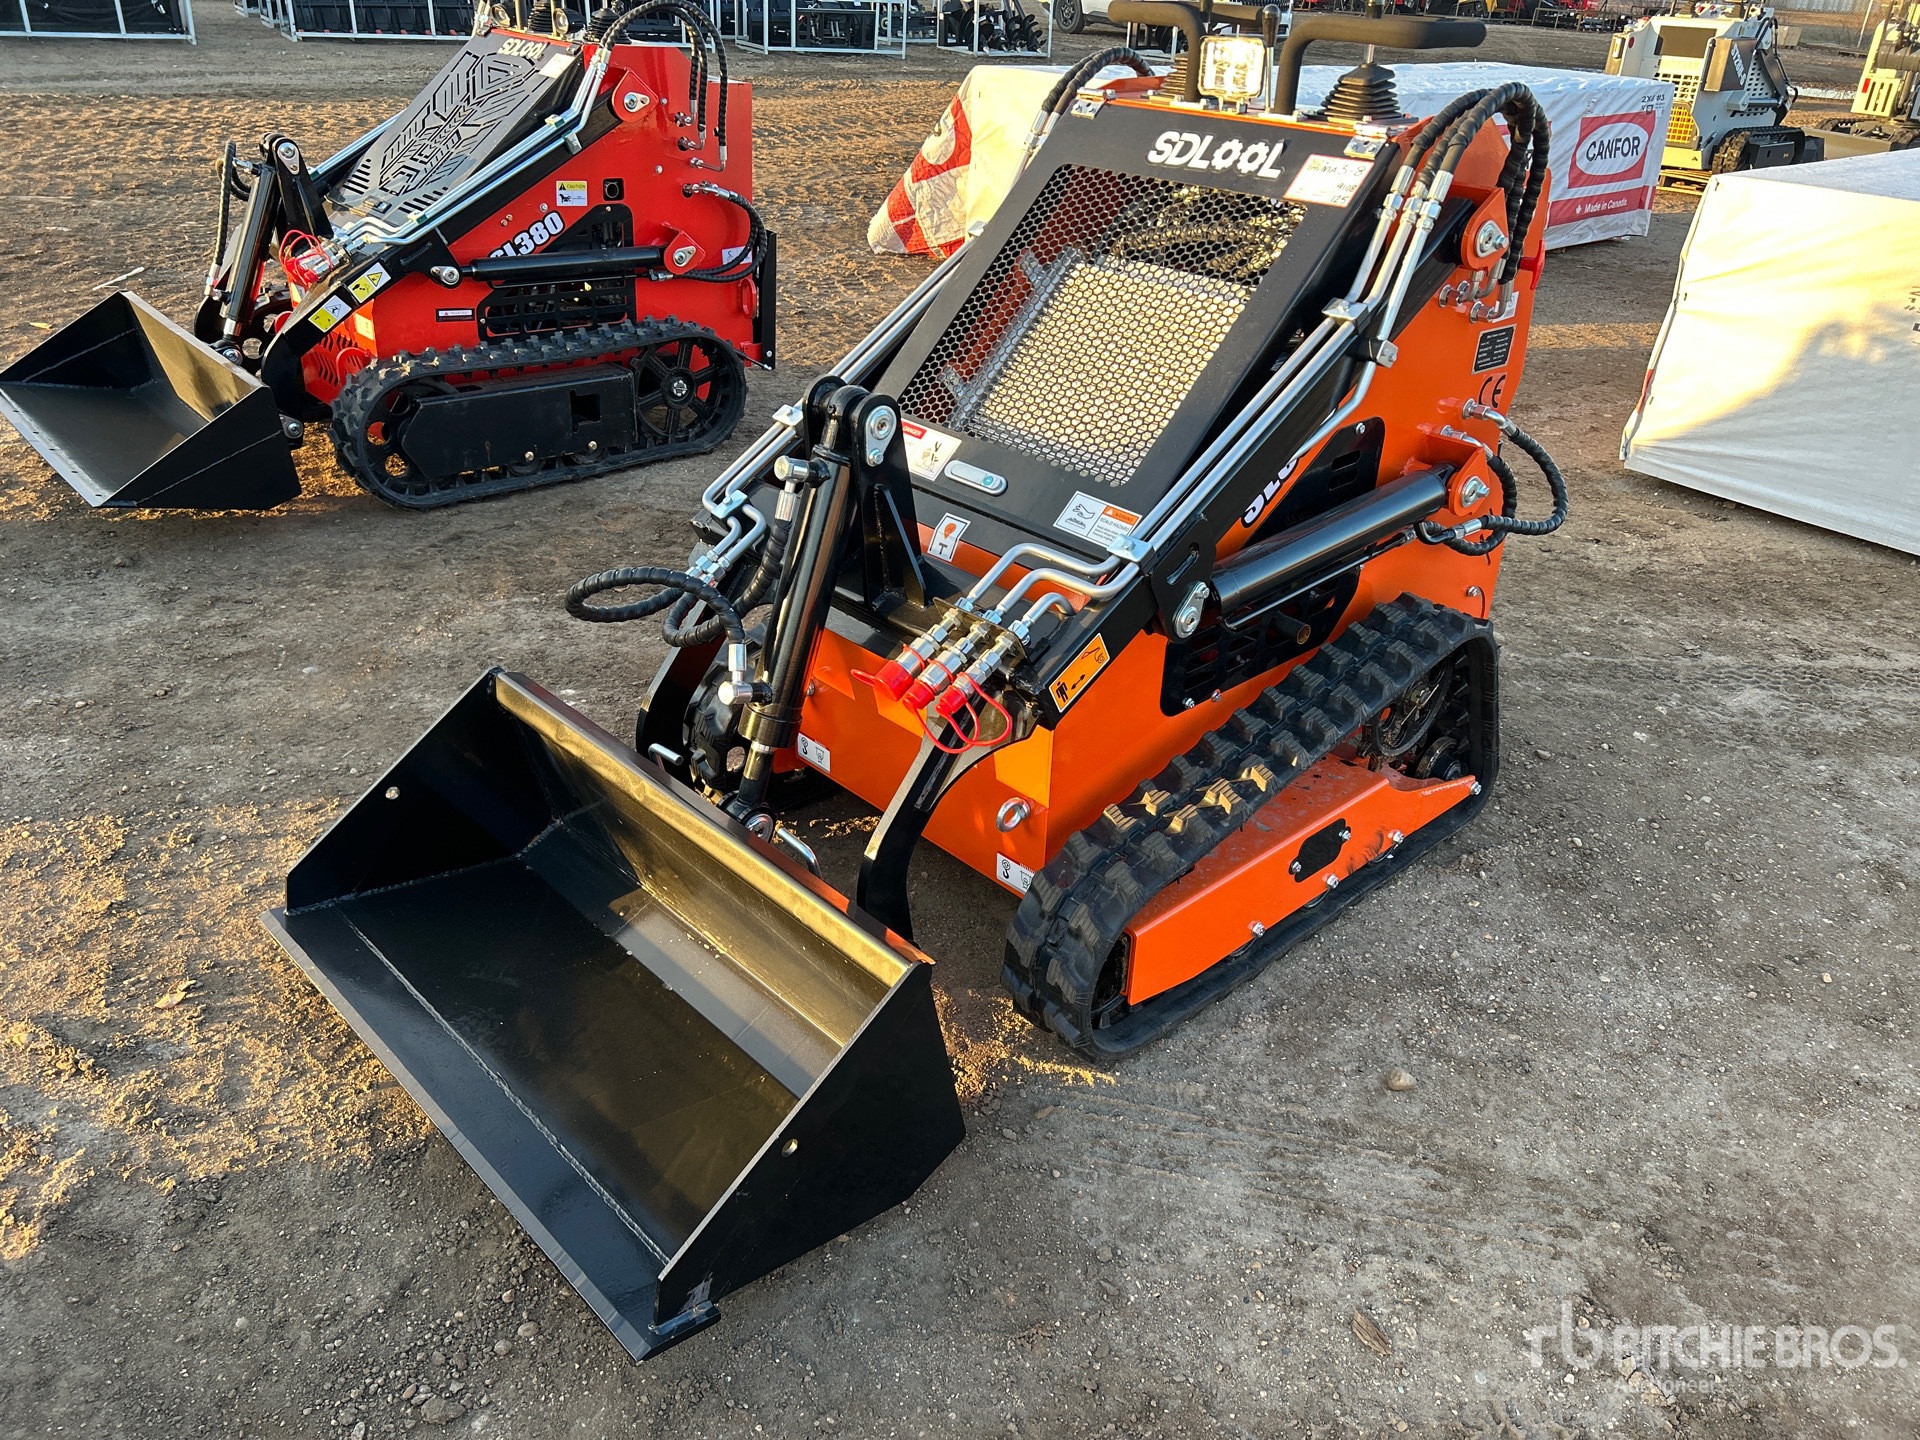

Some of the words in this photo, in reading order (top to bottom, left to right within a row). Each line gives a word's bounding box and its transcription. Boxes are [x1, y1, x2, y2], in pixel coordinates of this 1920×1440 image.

[1586, 136, 1641, 162] CANFOR
[1584, 202, 1601, 213] Made
[1601, 200, 1608, 210] in
[904, 425, 923, 437] DANGER
